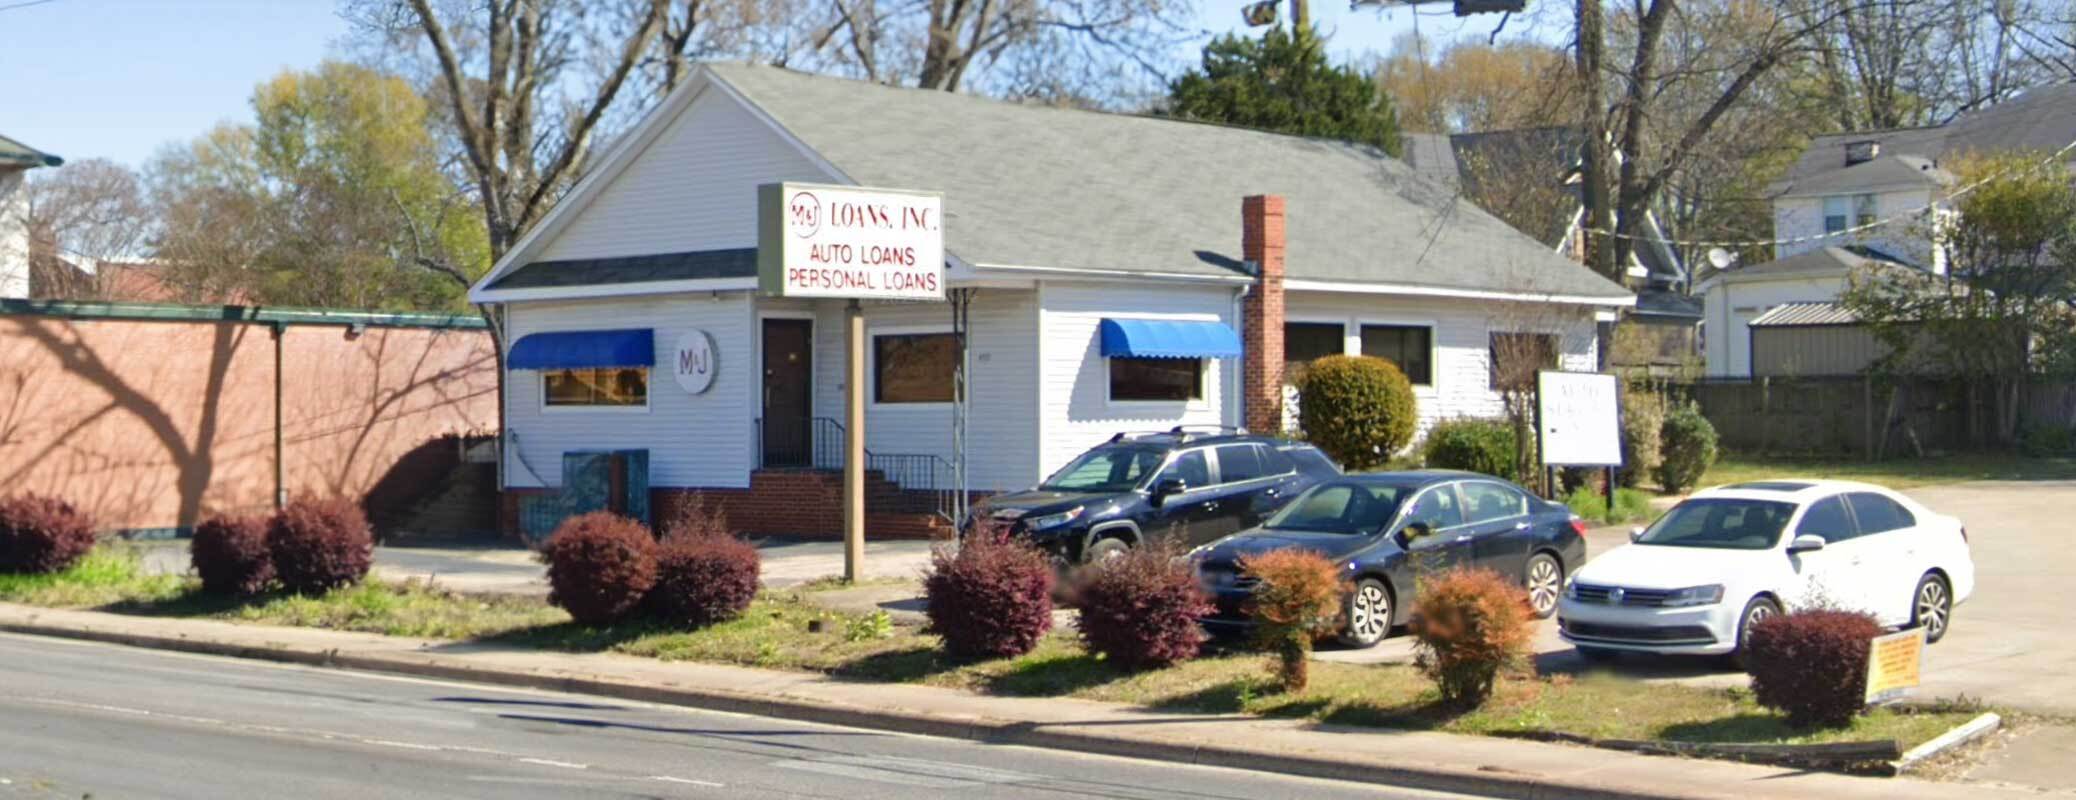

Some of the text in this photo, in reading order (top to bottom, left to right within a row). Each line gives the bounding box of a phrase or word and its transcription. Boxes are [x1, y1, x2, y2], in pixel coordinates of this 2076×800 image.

[902, 206, 938, 231] INC.
[810, 244, 916, 266] AUTO LOANS
[789, 268, 937, 292] PERSONAL LOANS
